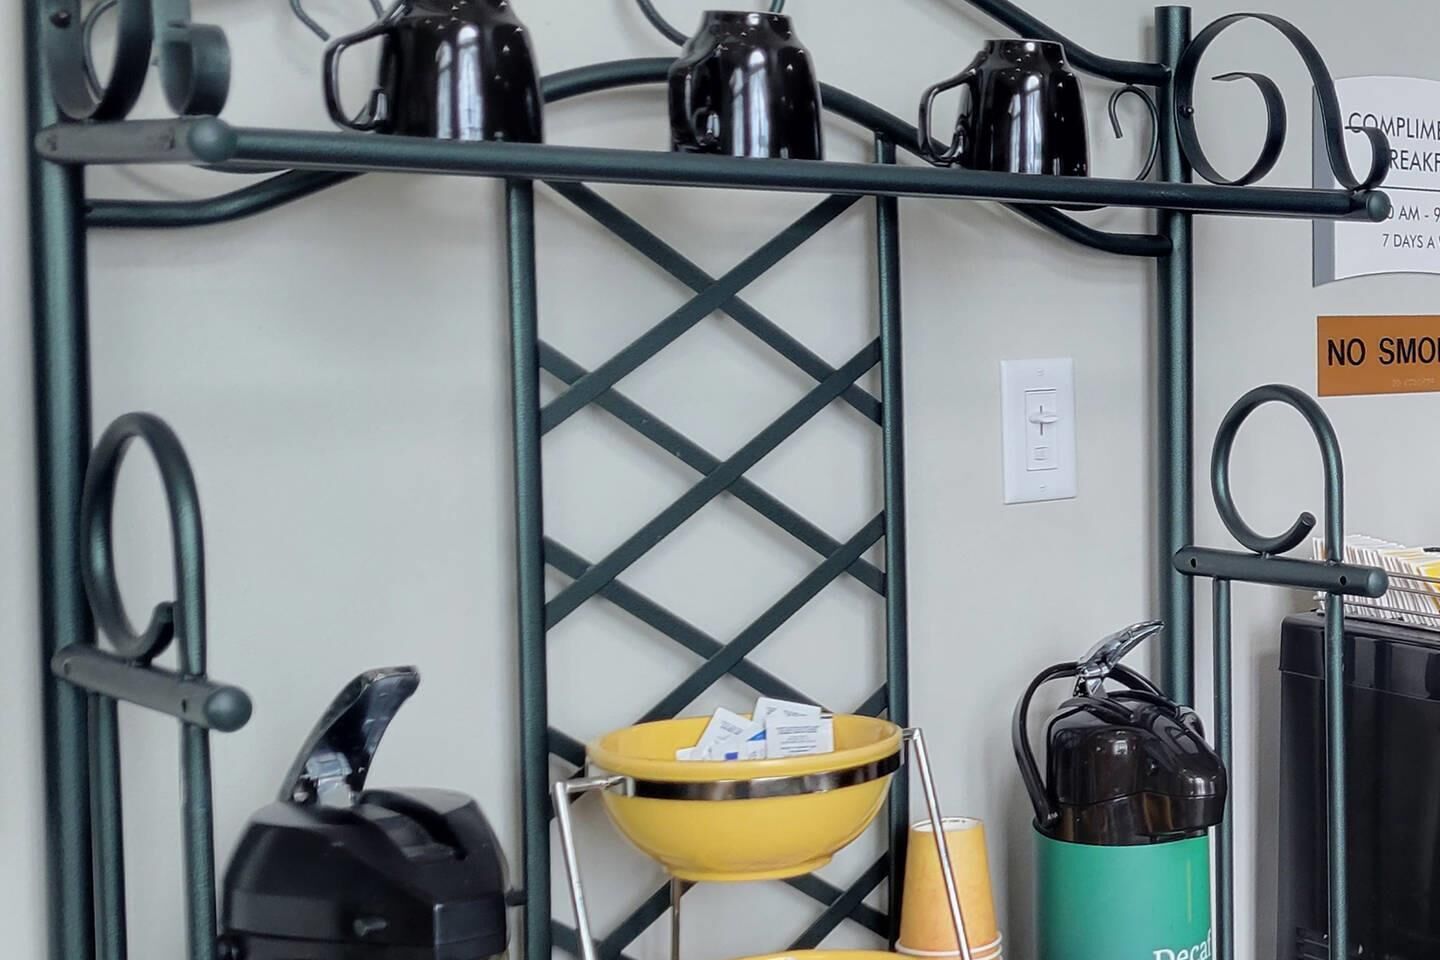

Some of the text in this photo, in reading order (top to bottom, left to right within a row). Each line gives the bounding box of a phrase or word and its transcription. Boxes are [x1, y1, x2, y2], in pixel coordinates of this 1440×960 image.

[1398, 205, 1420, 220] AM
[1383, 234, 1389, 247] 7
[1393, 234, 1423, 249] DAYS
[1427, 237, 1435, 249] A
[1328, 338, 1366, 366] NO
